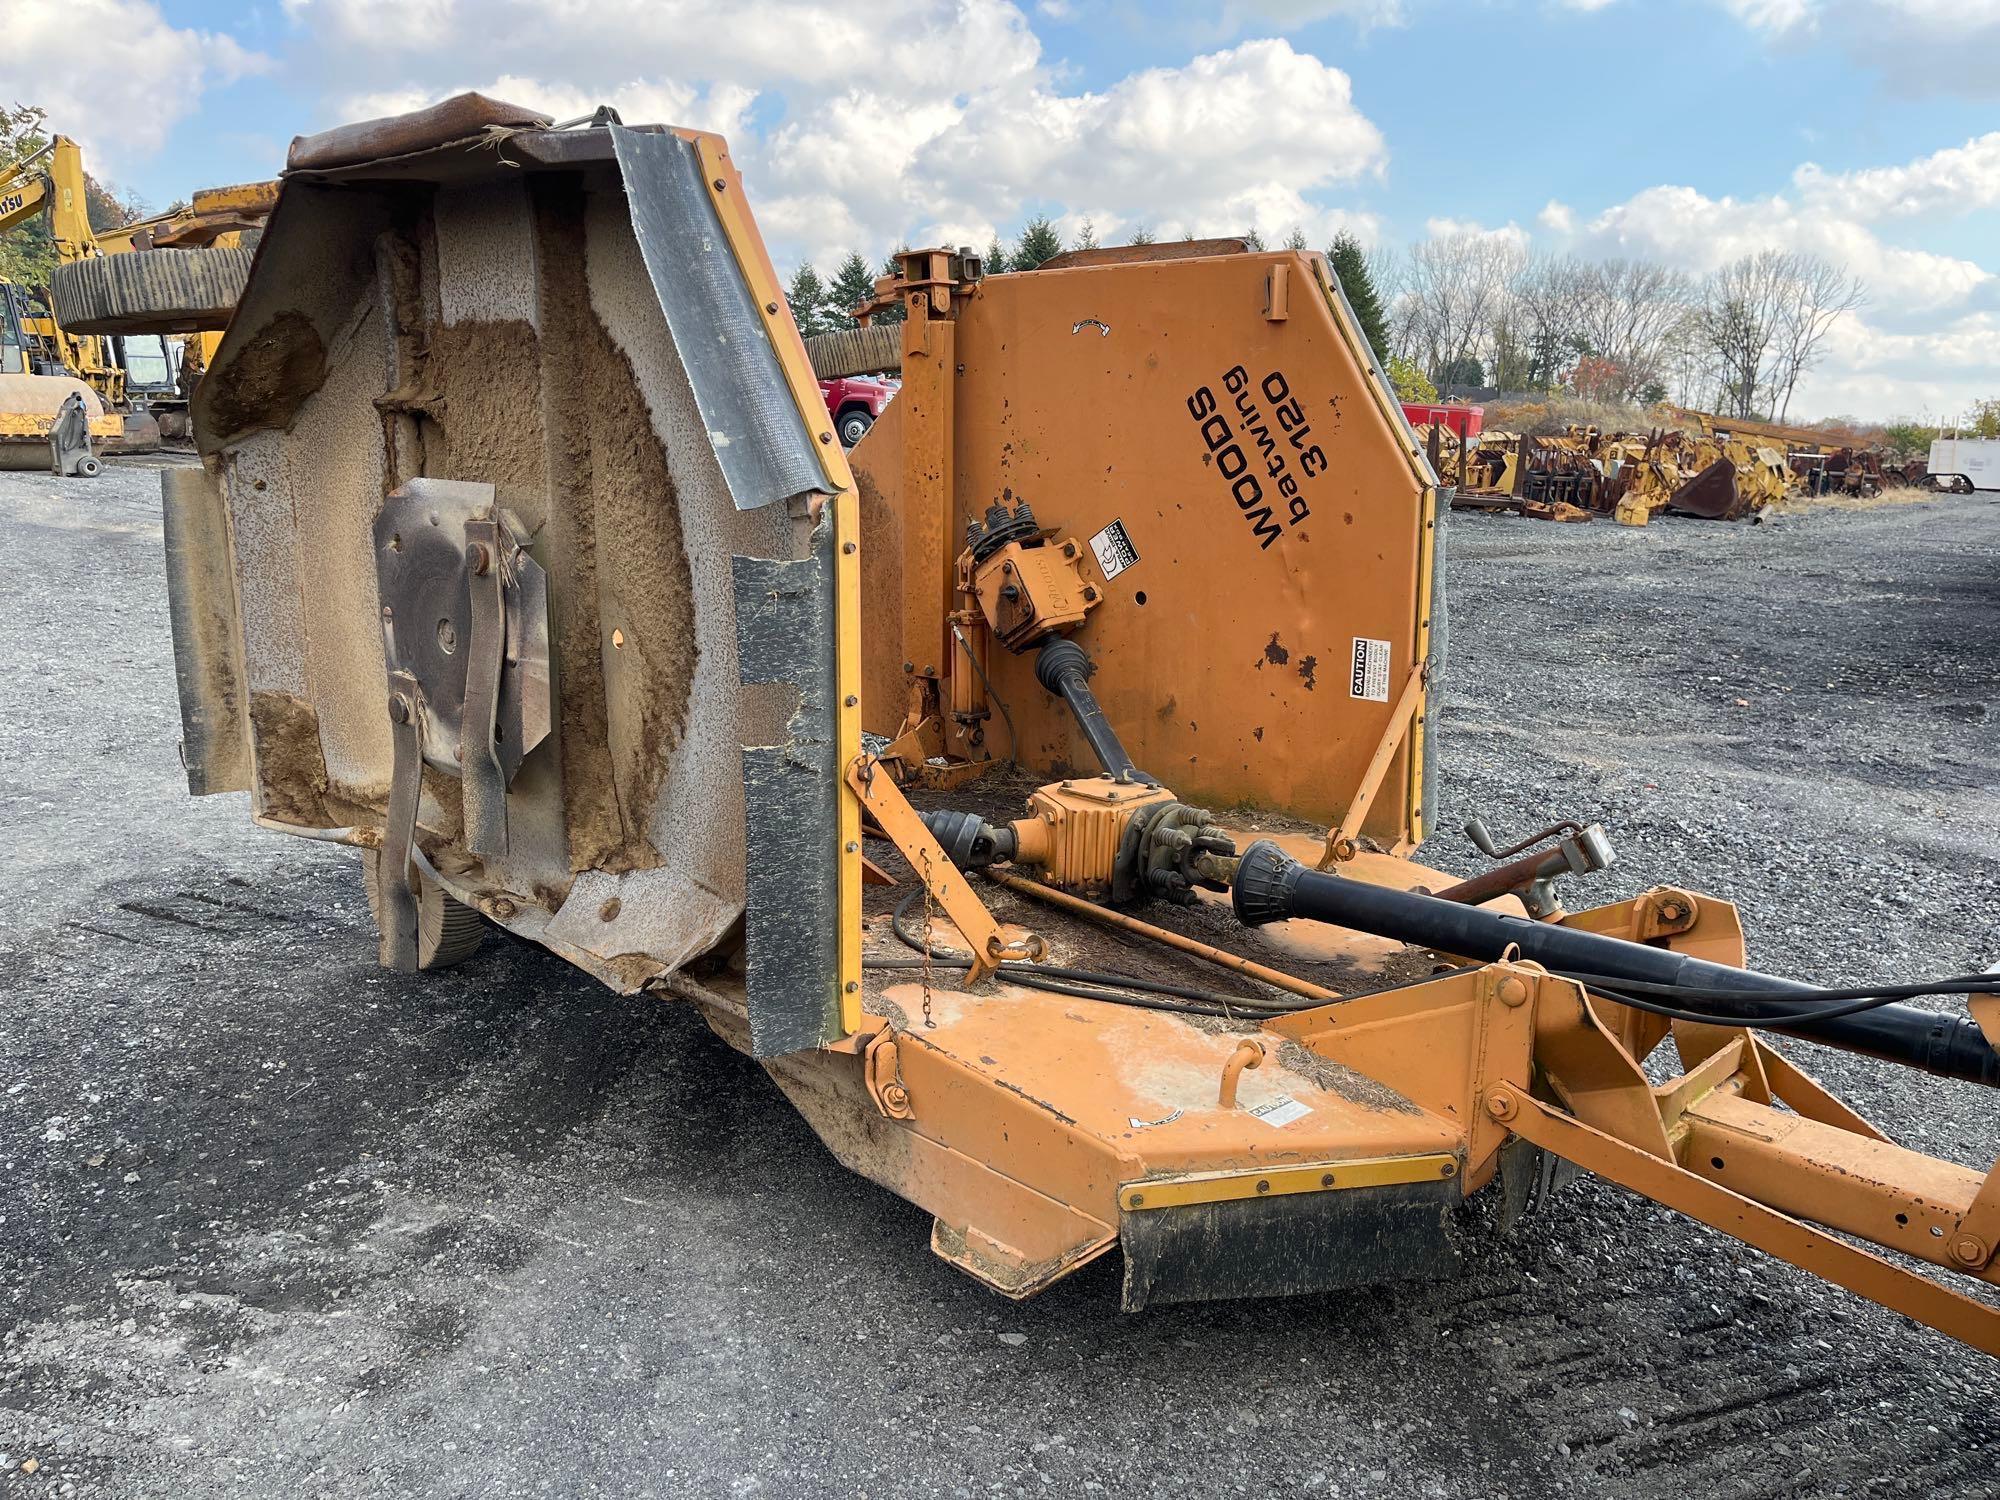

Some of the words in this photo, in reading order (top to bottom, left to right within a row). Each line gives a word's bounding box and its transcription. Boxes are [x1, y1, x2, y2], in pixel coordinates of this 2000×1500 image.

[1187, 386, 1283, 551] WOODS
[1222, 365, 1311, 527] batwing
[1261, 371, 1328, 478] 3120
[1110, 526, 1131, 565] POWER
[1354, 641, 1366, 694] CAUTION
